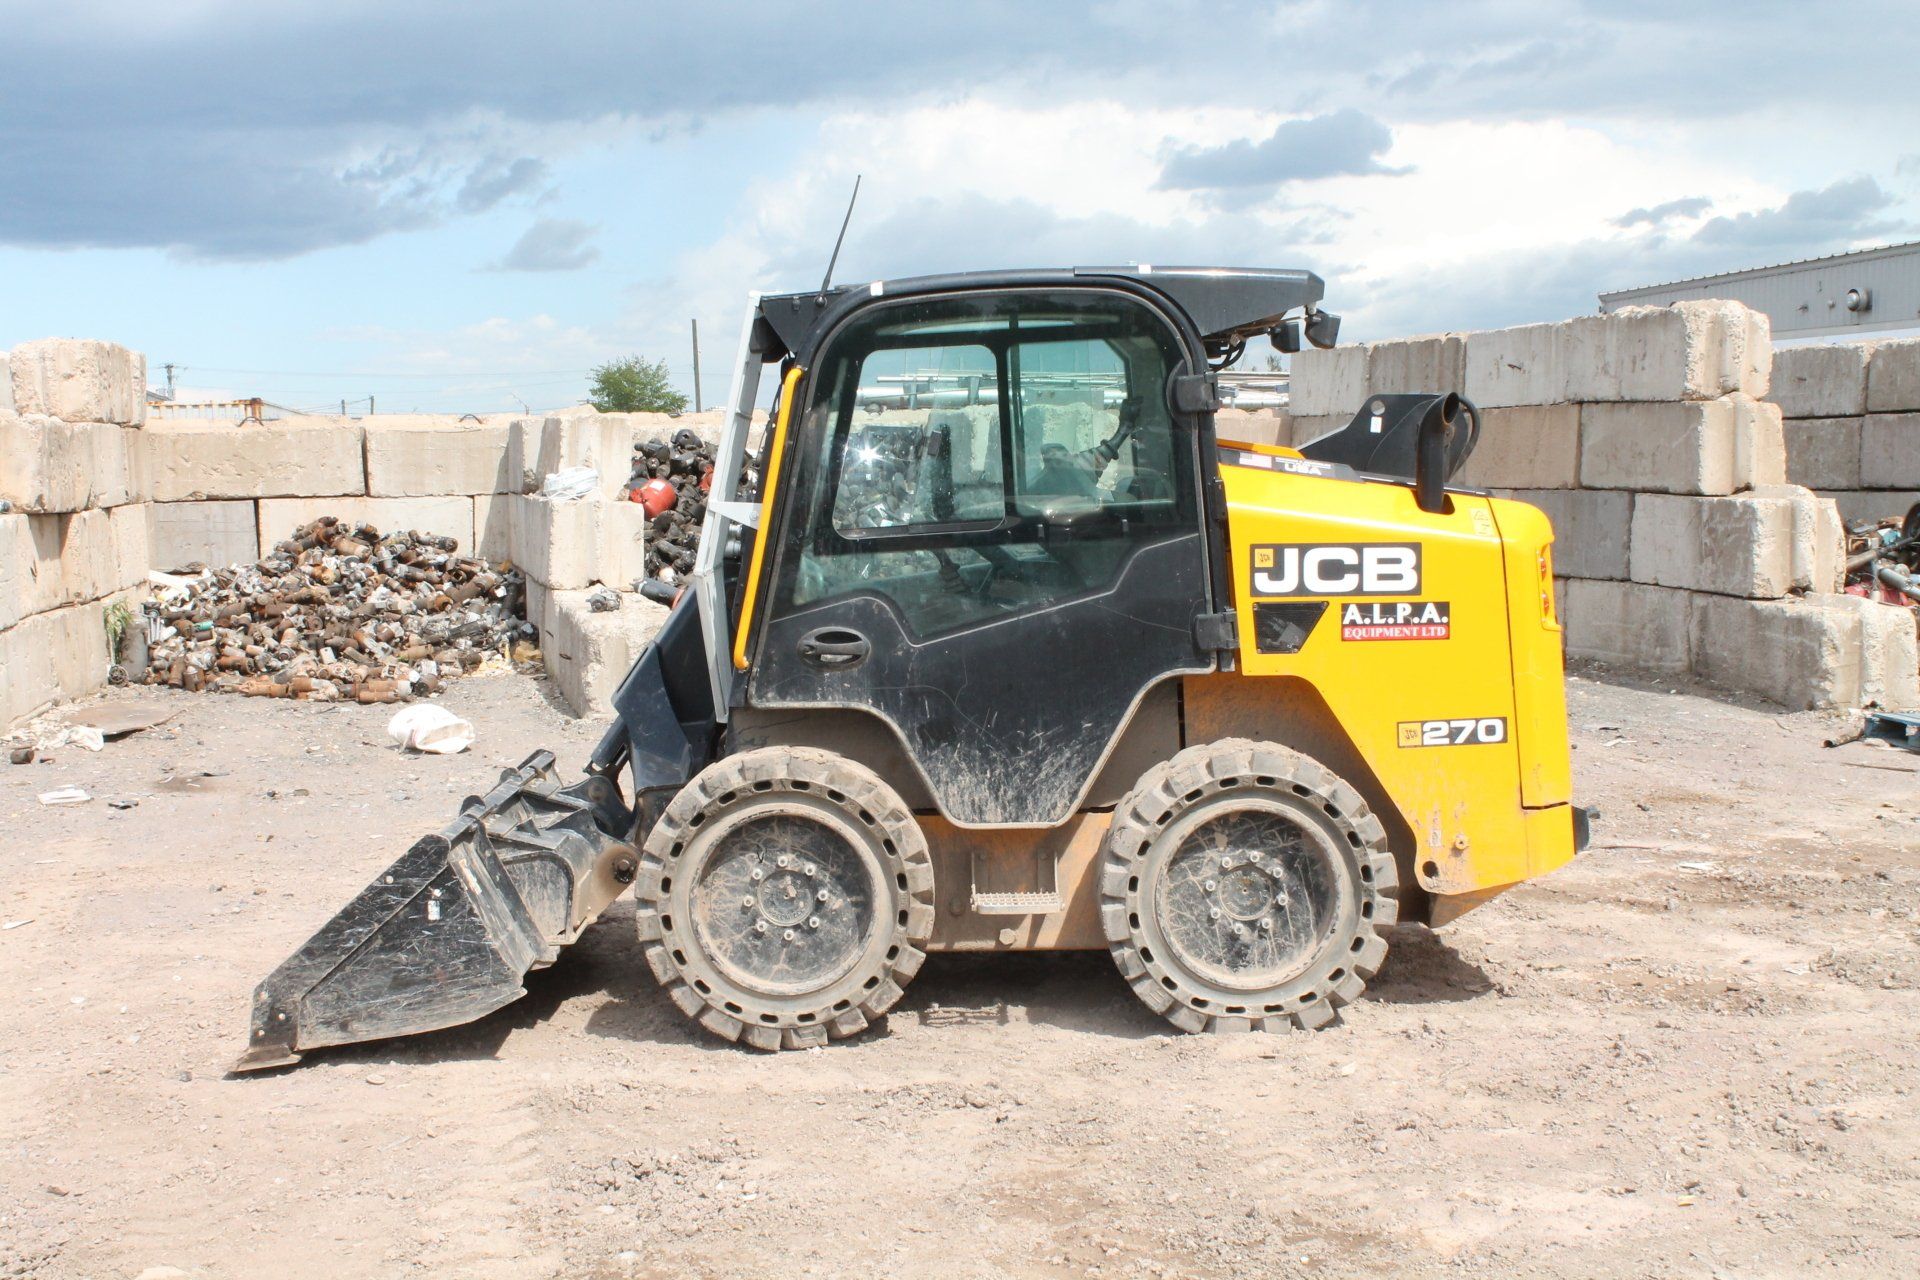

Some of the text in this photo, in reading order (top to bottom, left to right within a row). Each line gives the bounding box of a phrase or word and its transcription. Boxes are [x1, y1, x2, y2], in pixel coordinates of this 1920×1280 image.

[1254, 547, 1418, 593] JCB
[1342, 602, 1448, 625] A.L.P.A.
[1344, 626, 1446, 639] EQUIPMENT LTD
[1422, 718, 1504, 746] 270
